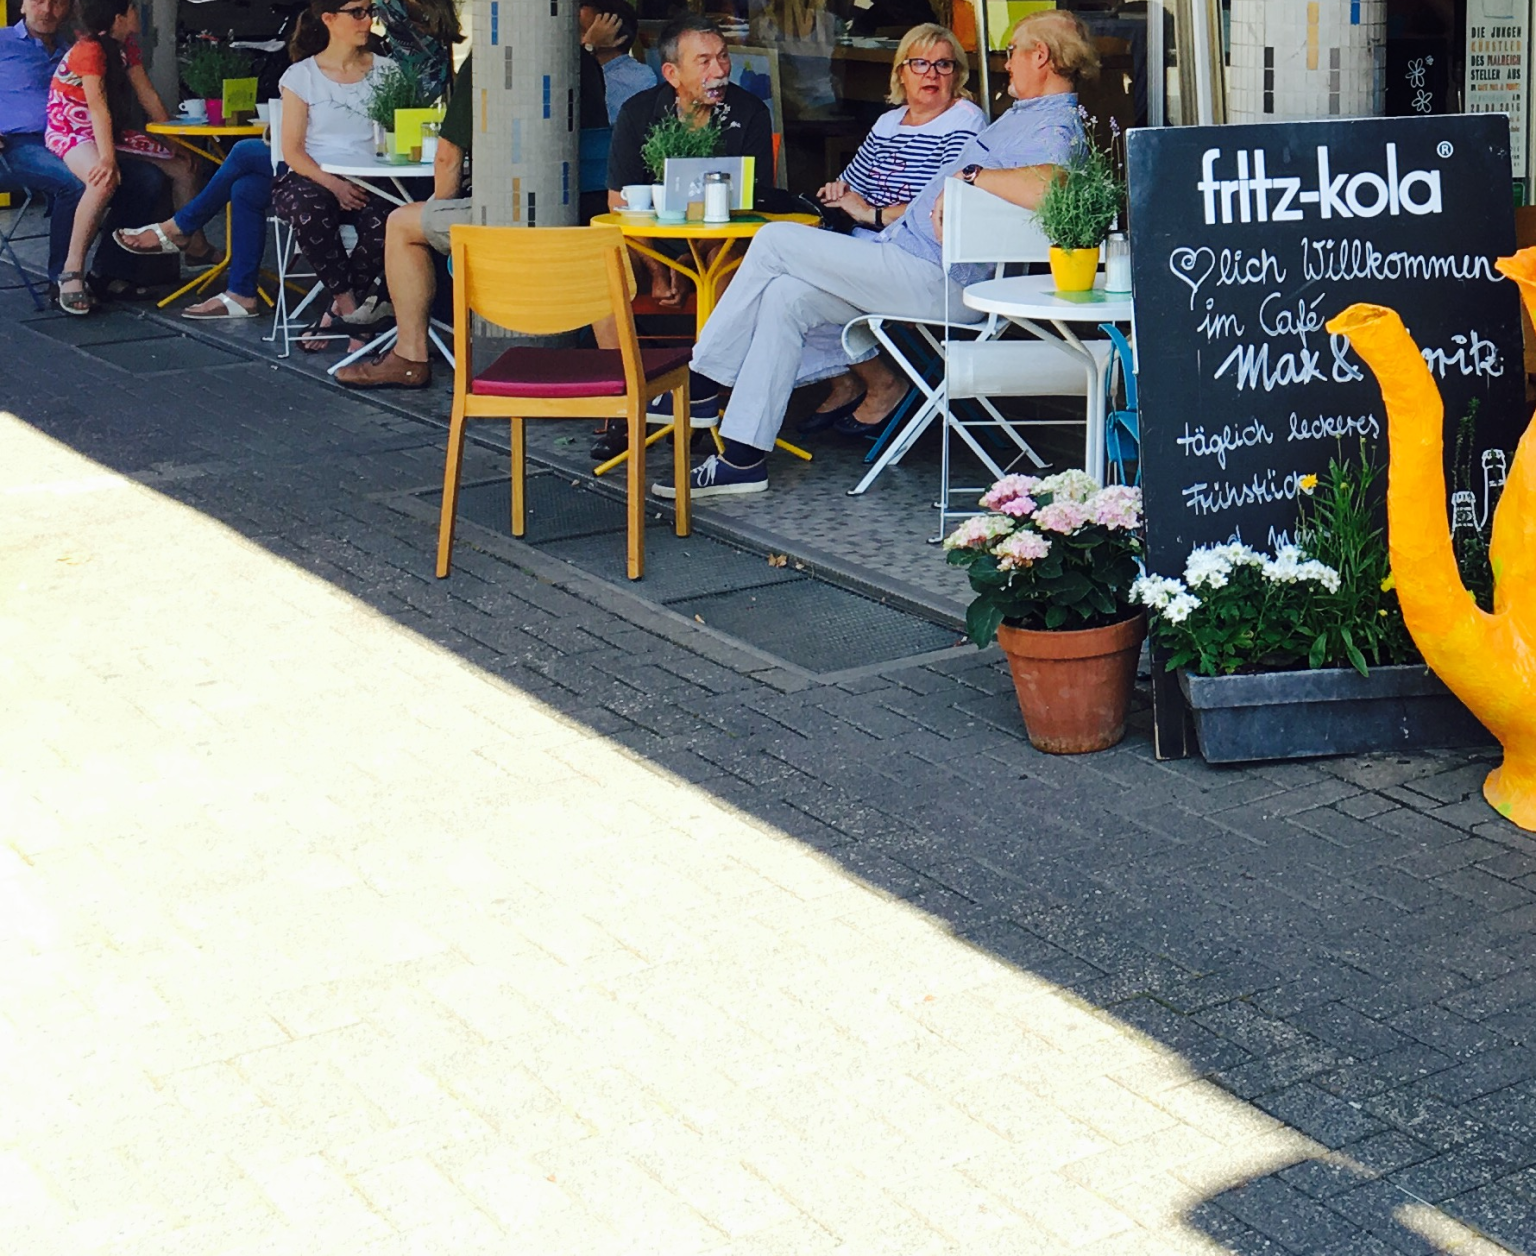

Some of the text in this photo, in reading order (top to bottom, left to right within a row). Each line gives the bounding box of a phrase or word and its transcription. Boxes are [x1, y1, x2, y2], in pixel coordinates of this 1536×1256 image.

[1216, 237, 1506, 286] lich Willkommen
[1197, 292, 1326, 346] im Café
[1214, 343, 1327, 392] Max
[1414, 328, 1504, 379] oritz
[1177, 411, 1381, 470] täglich leckeres
